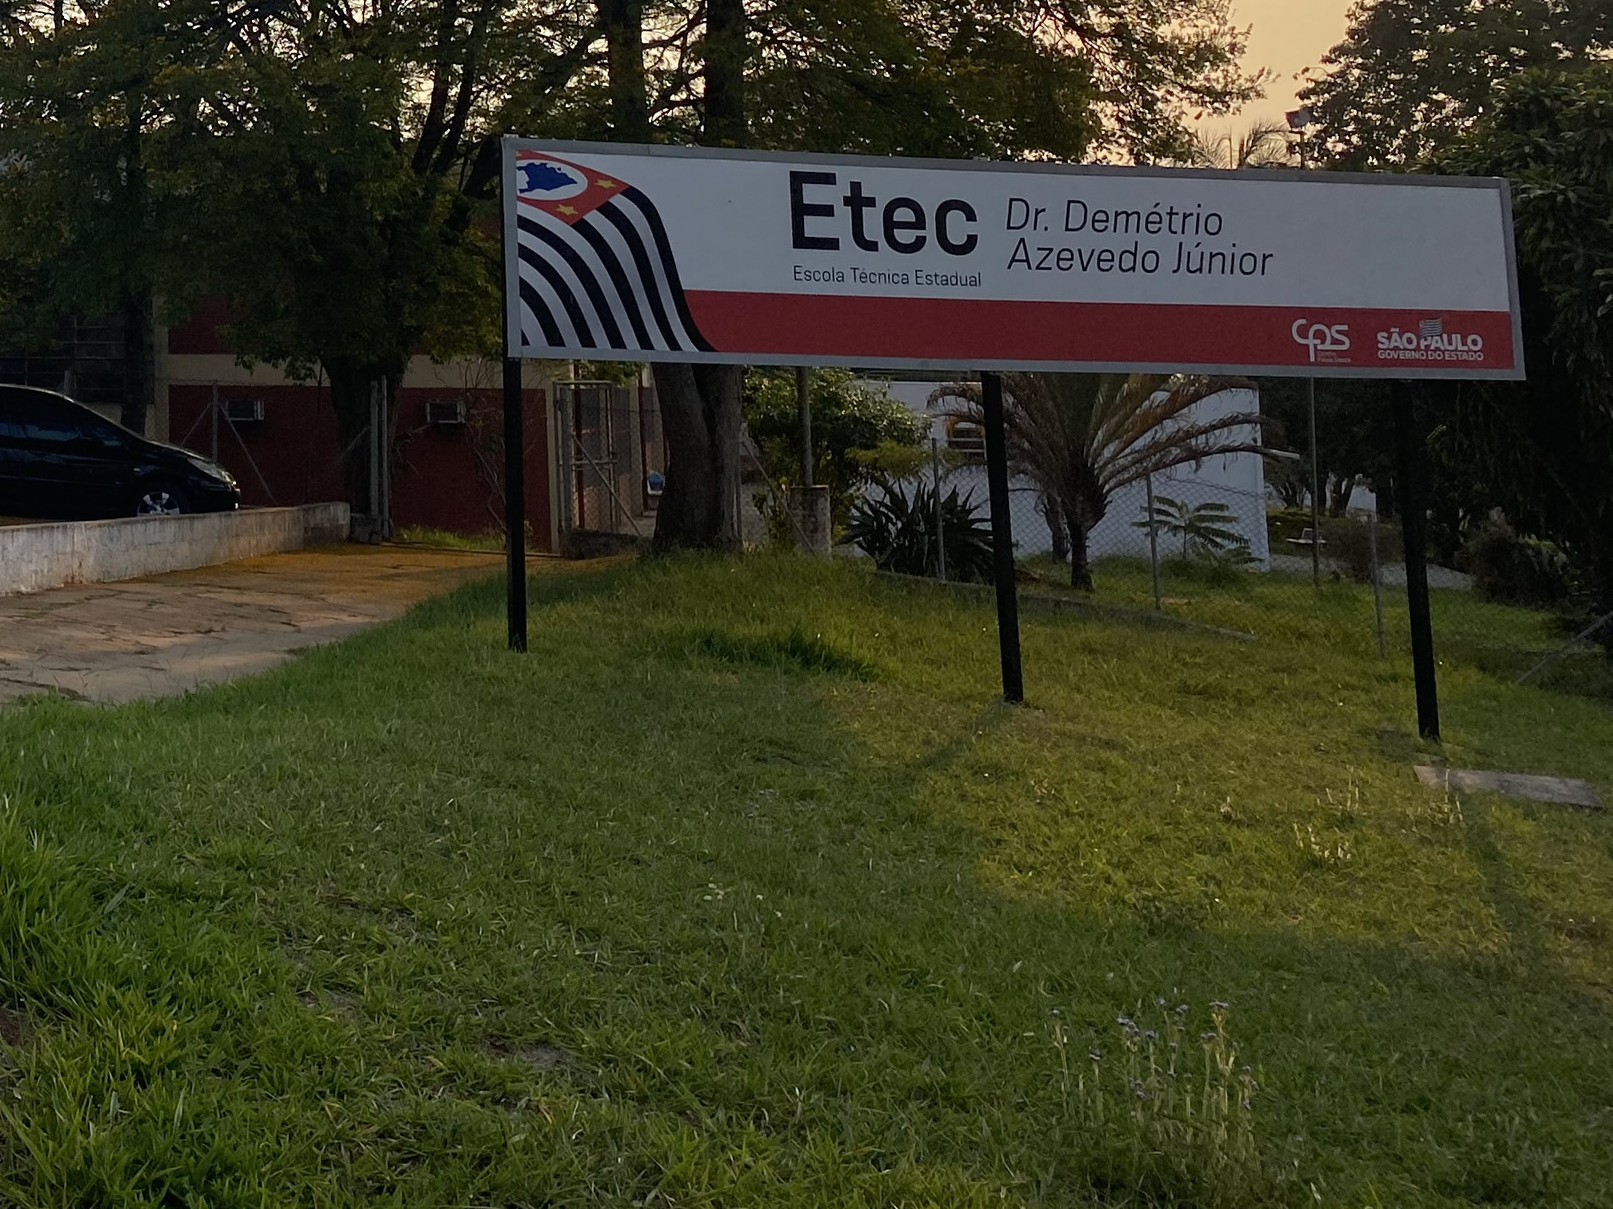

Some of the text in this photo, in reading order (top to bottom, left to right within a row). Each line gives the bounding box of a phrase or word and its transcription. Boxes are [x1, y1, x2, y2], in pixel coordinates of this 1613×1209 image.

[790, 170, 979, 256] Etec
[1006, 197, 1223, 236] Dr. Demétrio
[1007, 237, 1274, 276] Azevedo Júnior
[793, 265, 982, 287] Escola Técnica Estadual
[1377, 327, 1483, 351] SÃO PAULO
[1377, 350, 1484, 361] GOVERNO DO ESTADO
